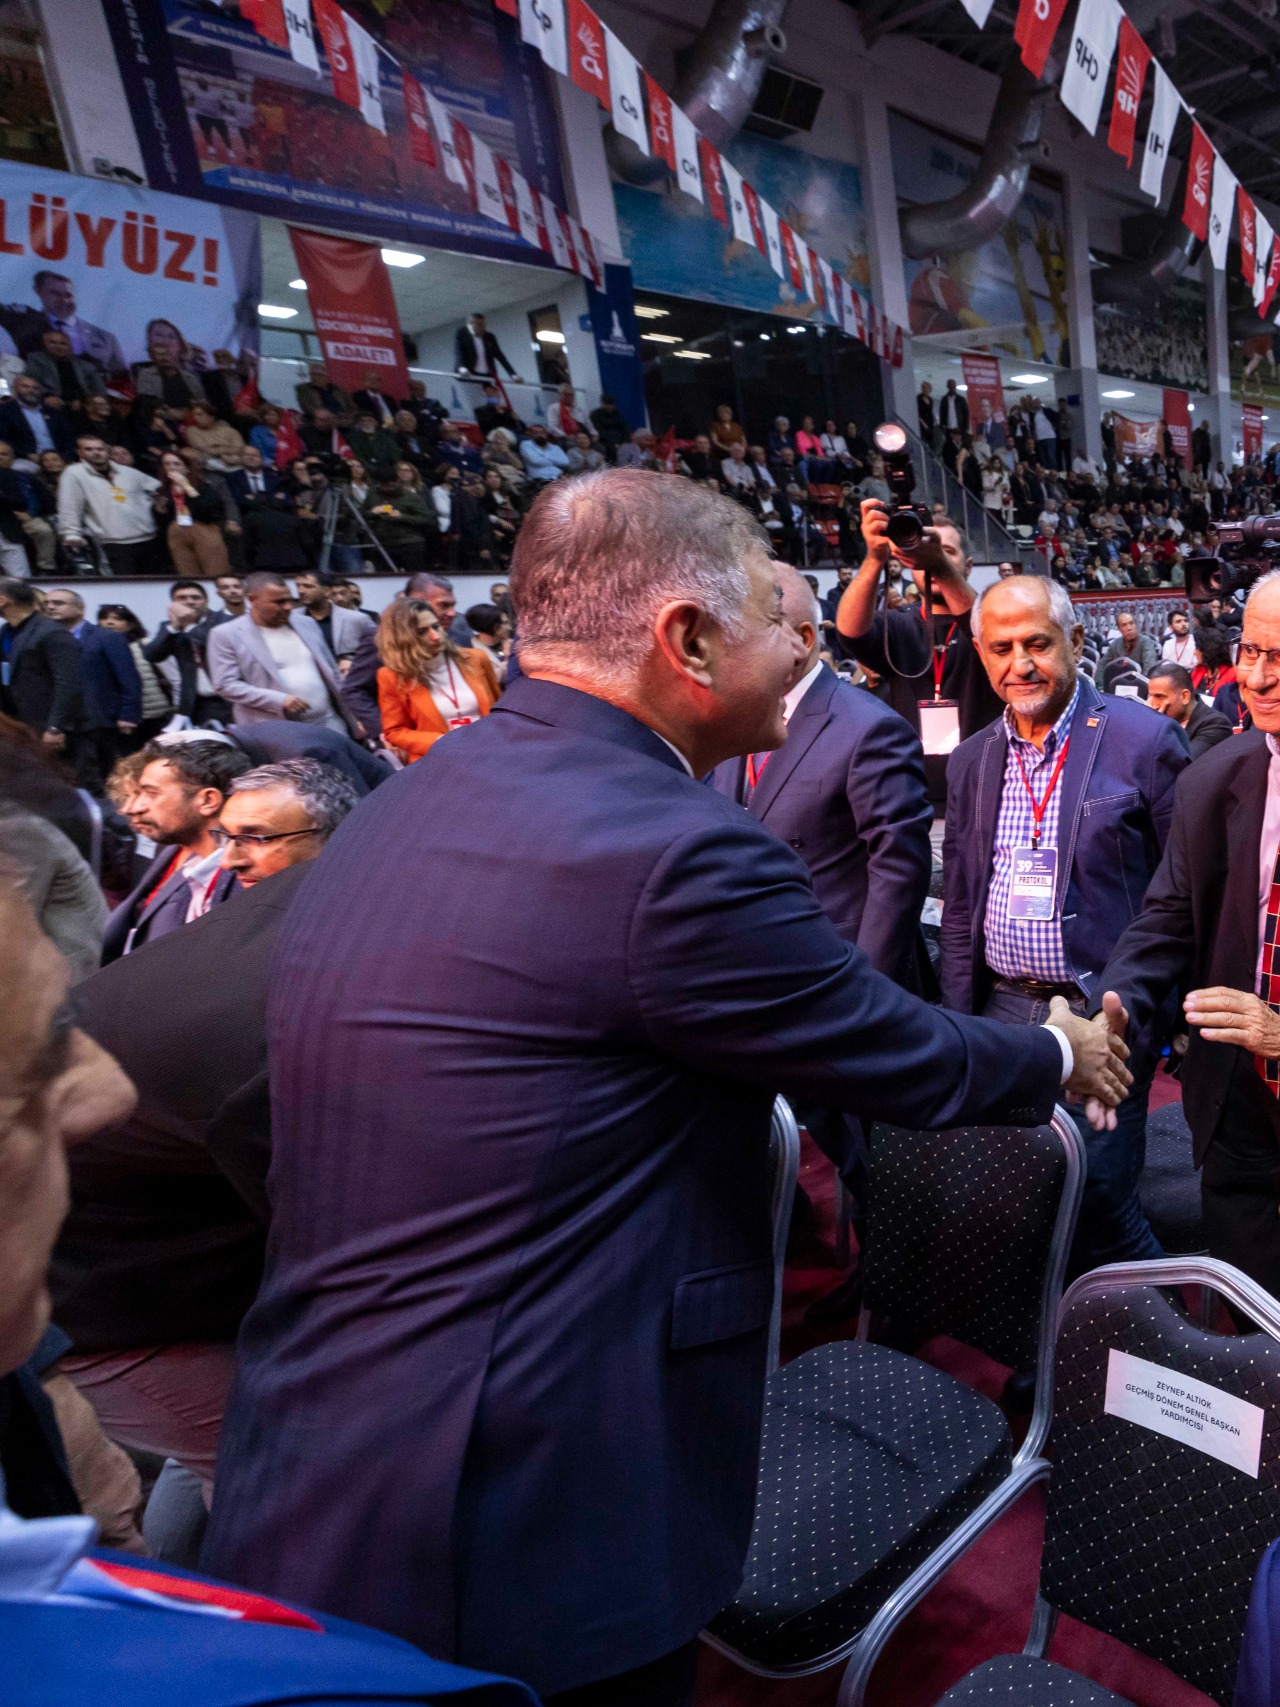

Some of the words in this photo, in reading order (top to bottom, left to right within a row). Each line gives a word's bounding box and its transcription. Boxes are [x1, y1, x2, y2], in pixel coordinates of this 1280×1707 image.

[1019, 876, 1048, 884] PROTOKOL
[1156, 1381, 1185, 1397] ZEYNEP
[1186, 1393, 1212, 1409] ALTIOK
[1125, 1383, 1155, 1400] GEÇMİŞ
[1156, 1394, 1184, 1410] DÖNEM
[1185, 1406, 1210, 1422] GENEL
[1210, 1416, 1240, 1436] BAŞKAN
[1160, 1407, 1204, 1431] YARDIMCISI
